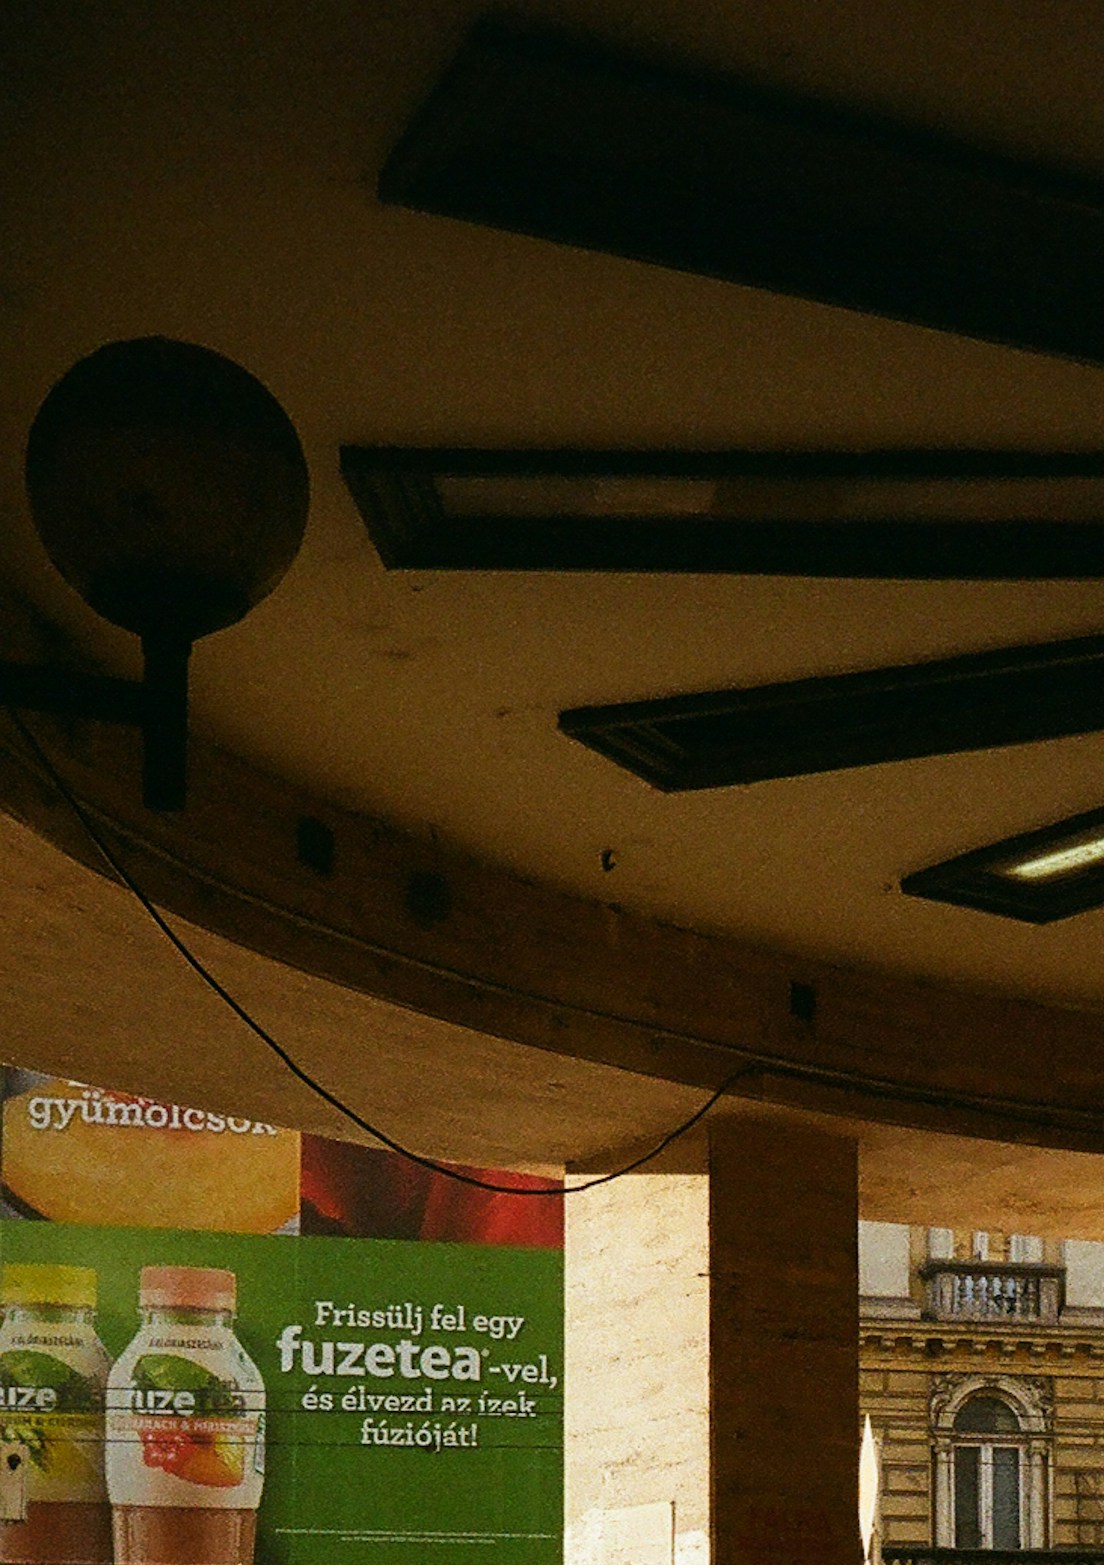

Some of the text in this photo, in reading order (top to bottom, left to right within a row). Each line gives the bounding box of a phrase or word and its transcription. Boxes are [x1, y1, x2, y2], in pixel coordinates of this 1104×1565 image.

[315, 1301, 525, 1340] Frissülj fel egy
[276, 1325, 481, 1381] fuzetea
[302, 1384, 537, 1417] és élvezd az ízek
[361, 1417, 479, 1453] fúzióját!
